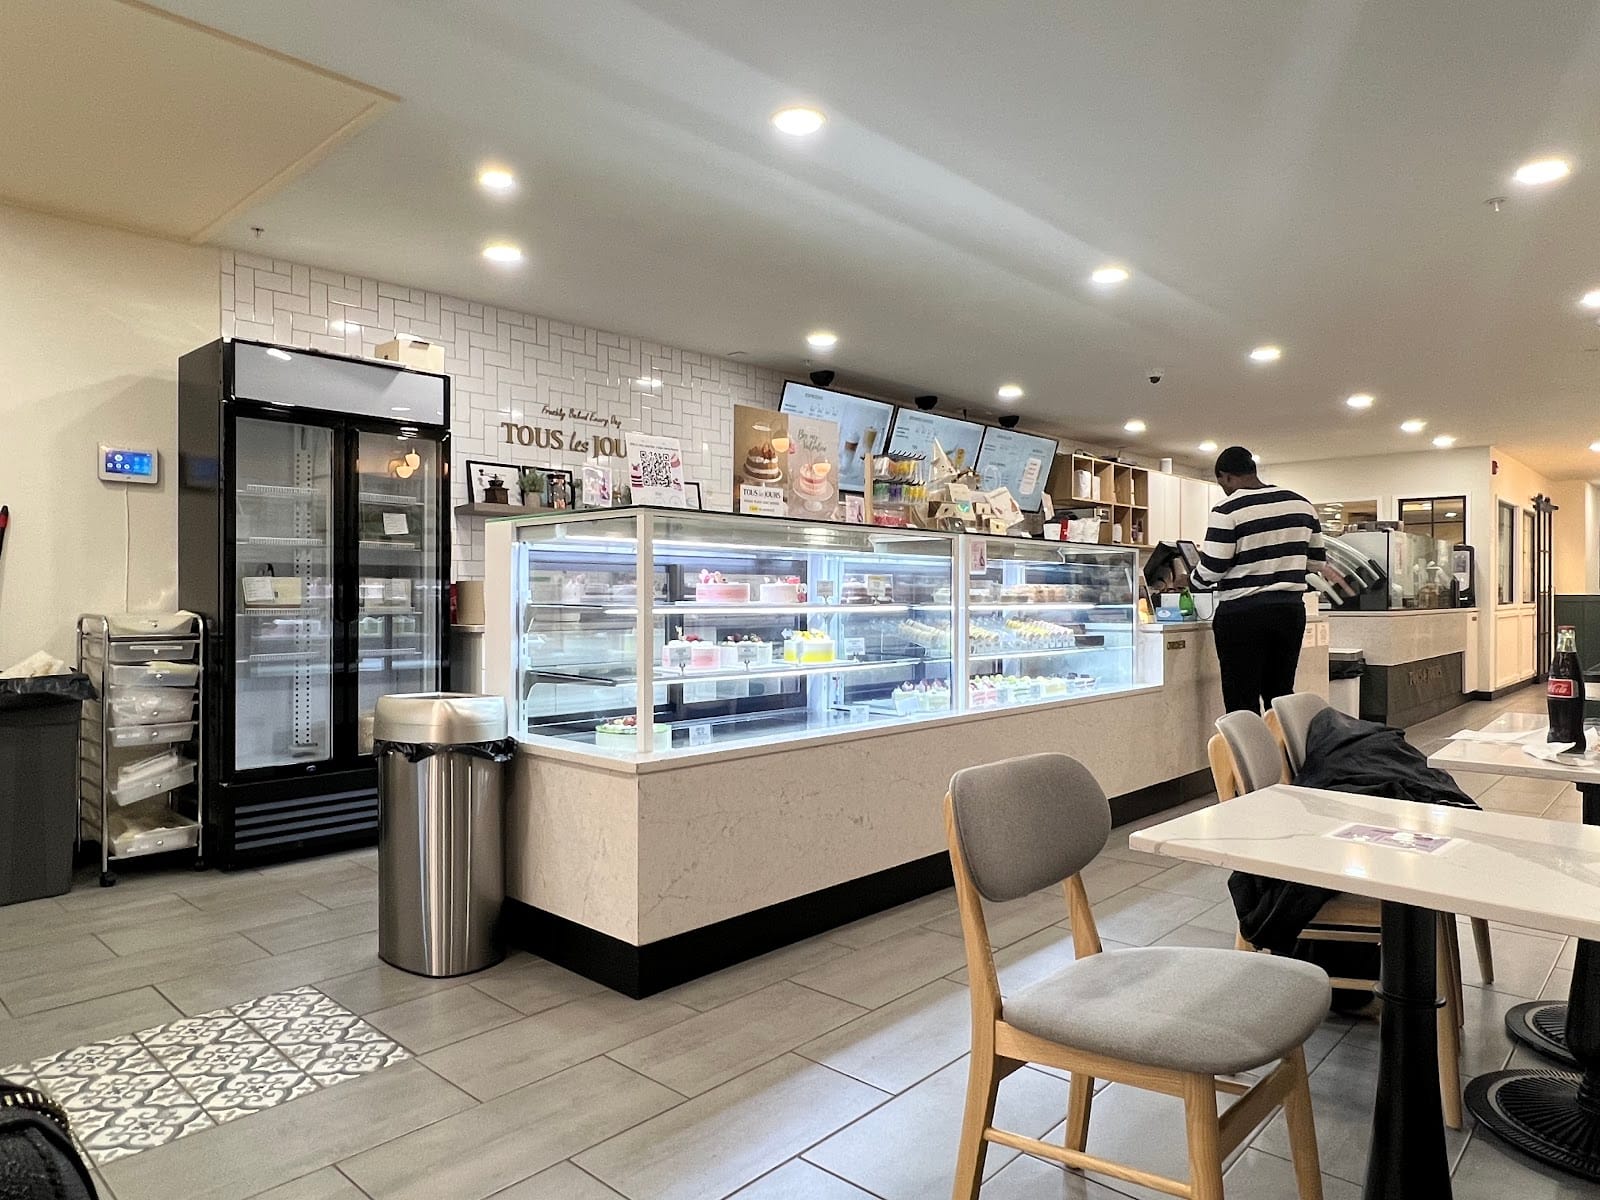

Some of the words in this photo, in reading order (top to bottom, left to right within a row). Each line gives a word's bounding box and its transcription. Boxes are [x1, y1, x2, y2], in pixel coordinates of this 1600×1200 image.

[611, 414, 622, 429] Day
[501, 422, 564, 450] TOUS
[569, 431, 589, 453] les
[592, 435, 627, 459] JOU
